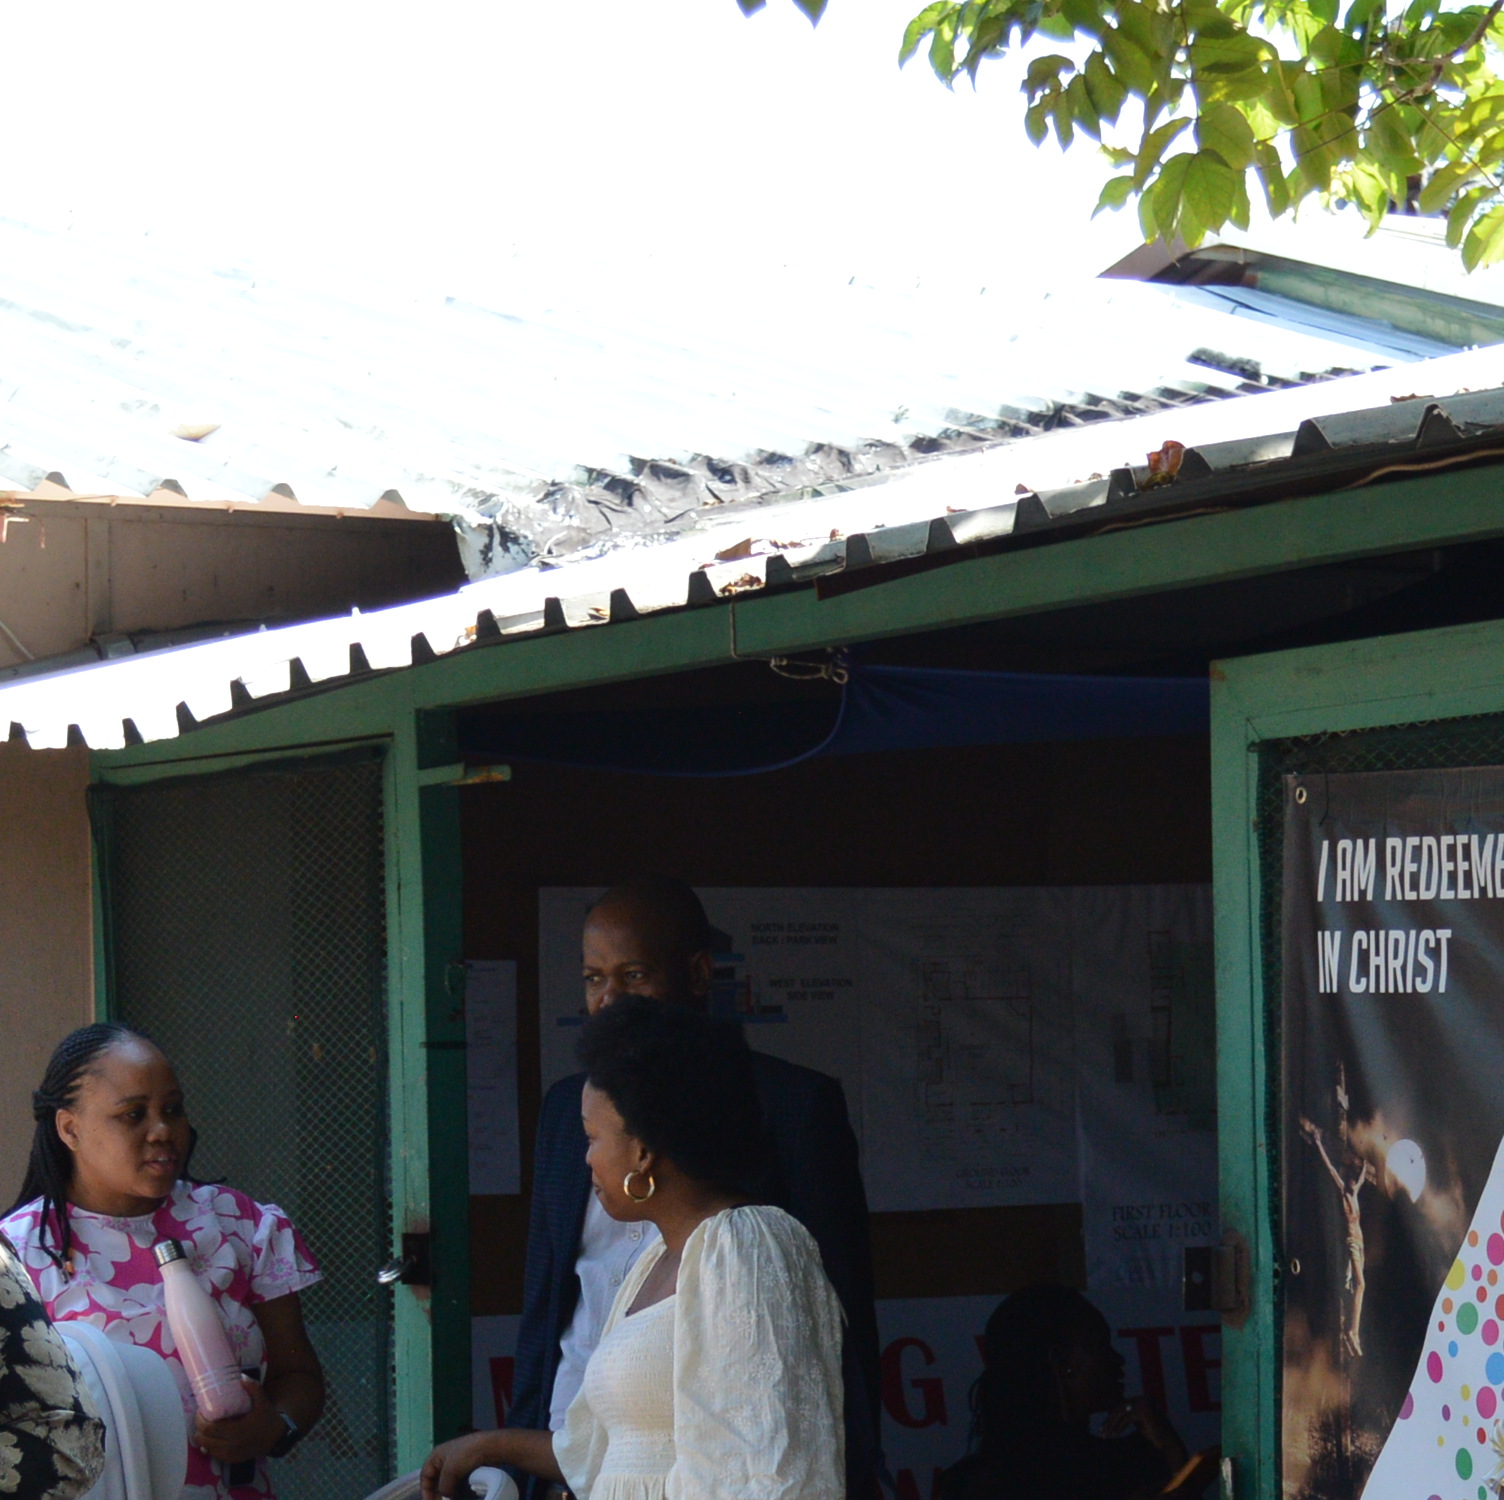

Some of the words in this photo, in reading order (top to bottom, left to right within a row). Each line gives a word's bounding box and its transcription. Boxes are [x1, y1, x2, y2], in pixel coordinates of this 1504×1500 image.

[1317, 840, 1330, 902] I
[1335, 837, 1376, 902] AM
[1317, 930, 1342, 993] IN
[1348, 928, 1453, 994] CHRIST
[1111, 1204, 1155, 1221] FIRST
[1159, 1201, 1212, 1219] FLOOR
[1113, 1223, 1161, 1241] SCALE
